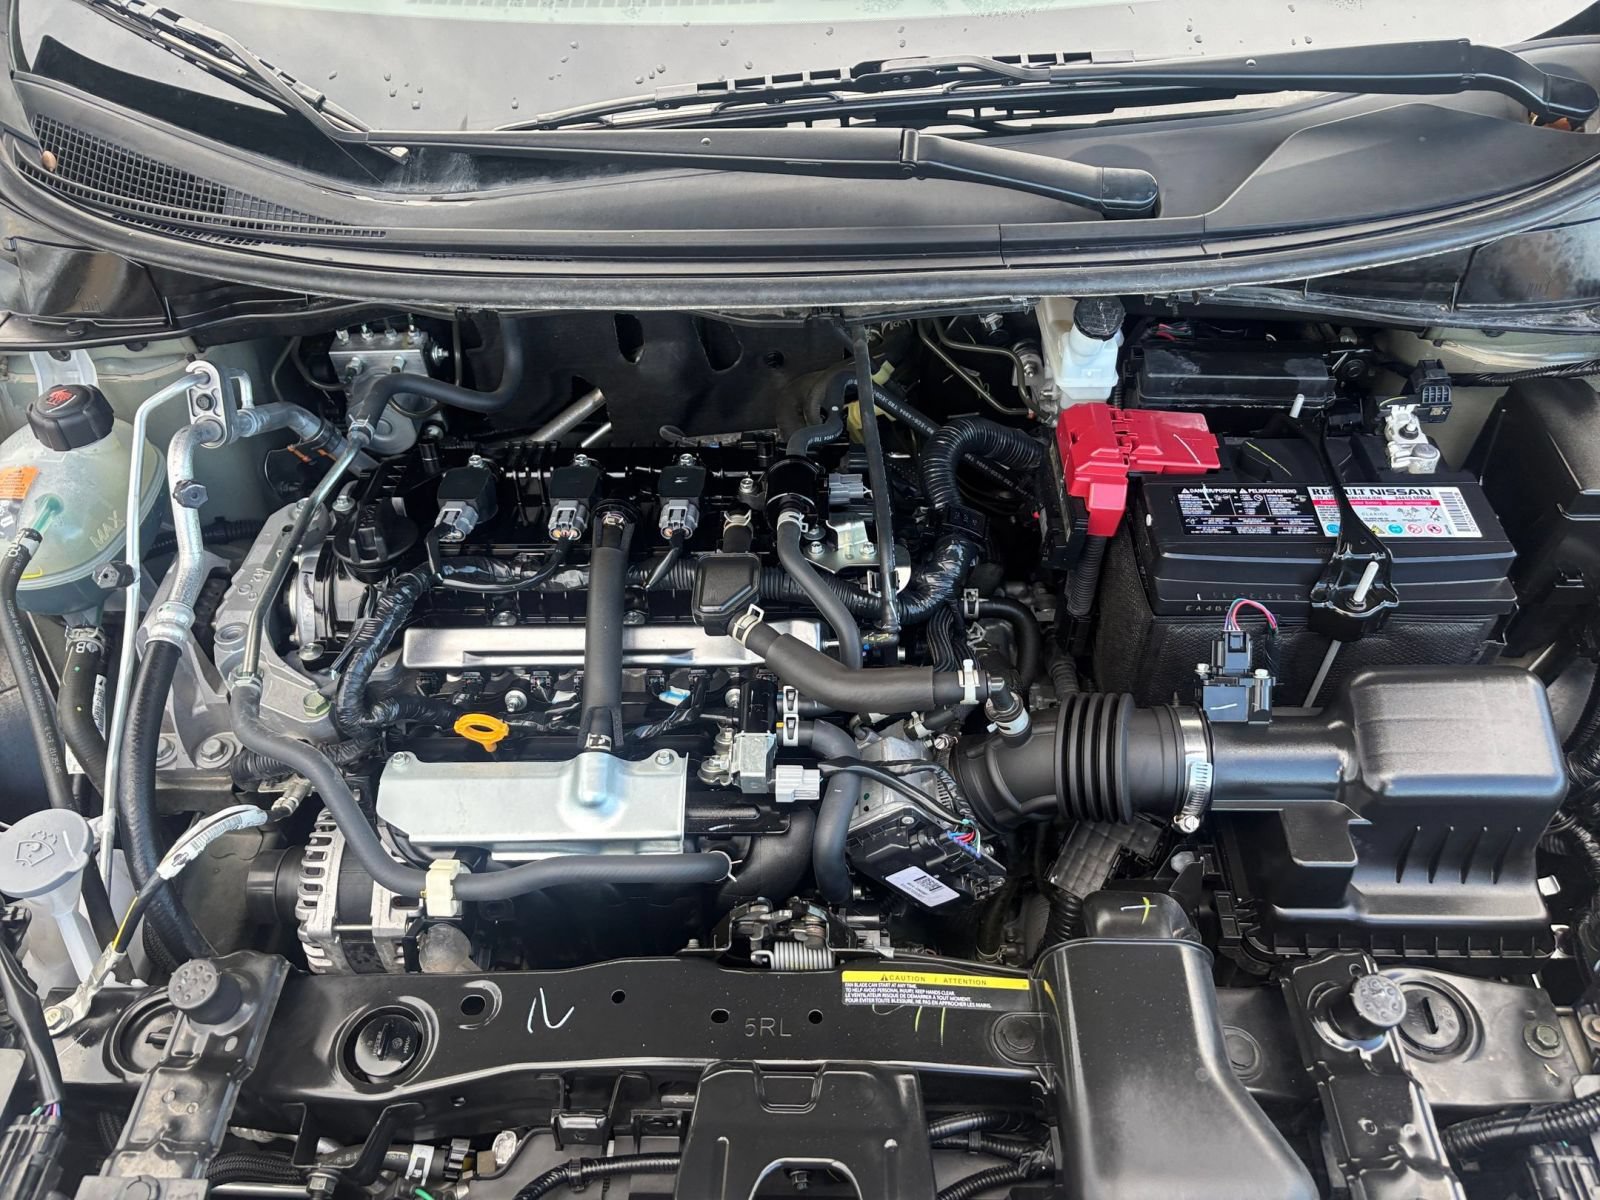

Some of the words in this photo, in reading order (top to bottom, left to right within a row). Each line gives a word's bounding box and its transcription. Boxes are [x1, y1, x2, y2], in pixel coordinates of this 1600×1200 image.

[1369, 488, 1432, 496] NISSAN
[88, 509, 119, 549] MAX
[889, 974, 926, 982] CAUTION
[943, 977, 987, 986] ATTENTION
[744, 1016, 793, 1038] 5RL
